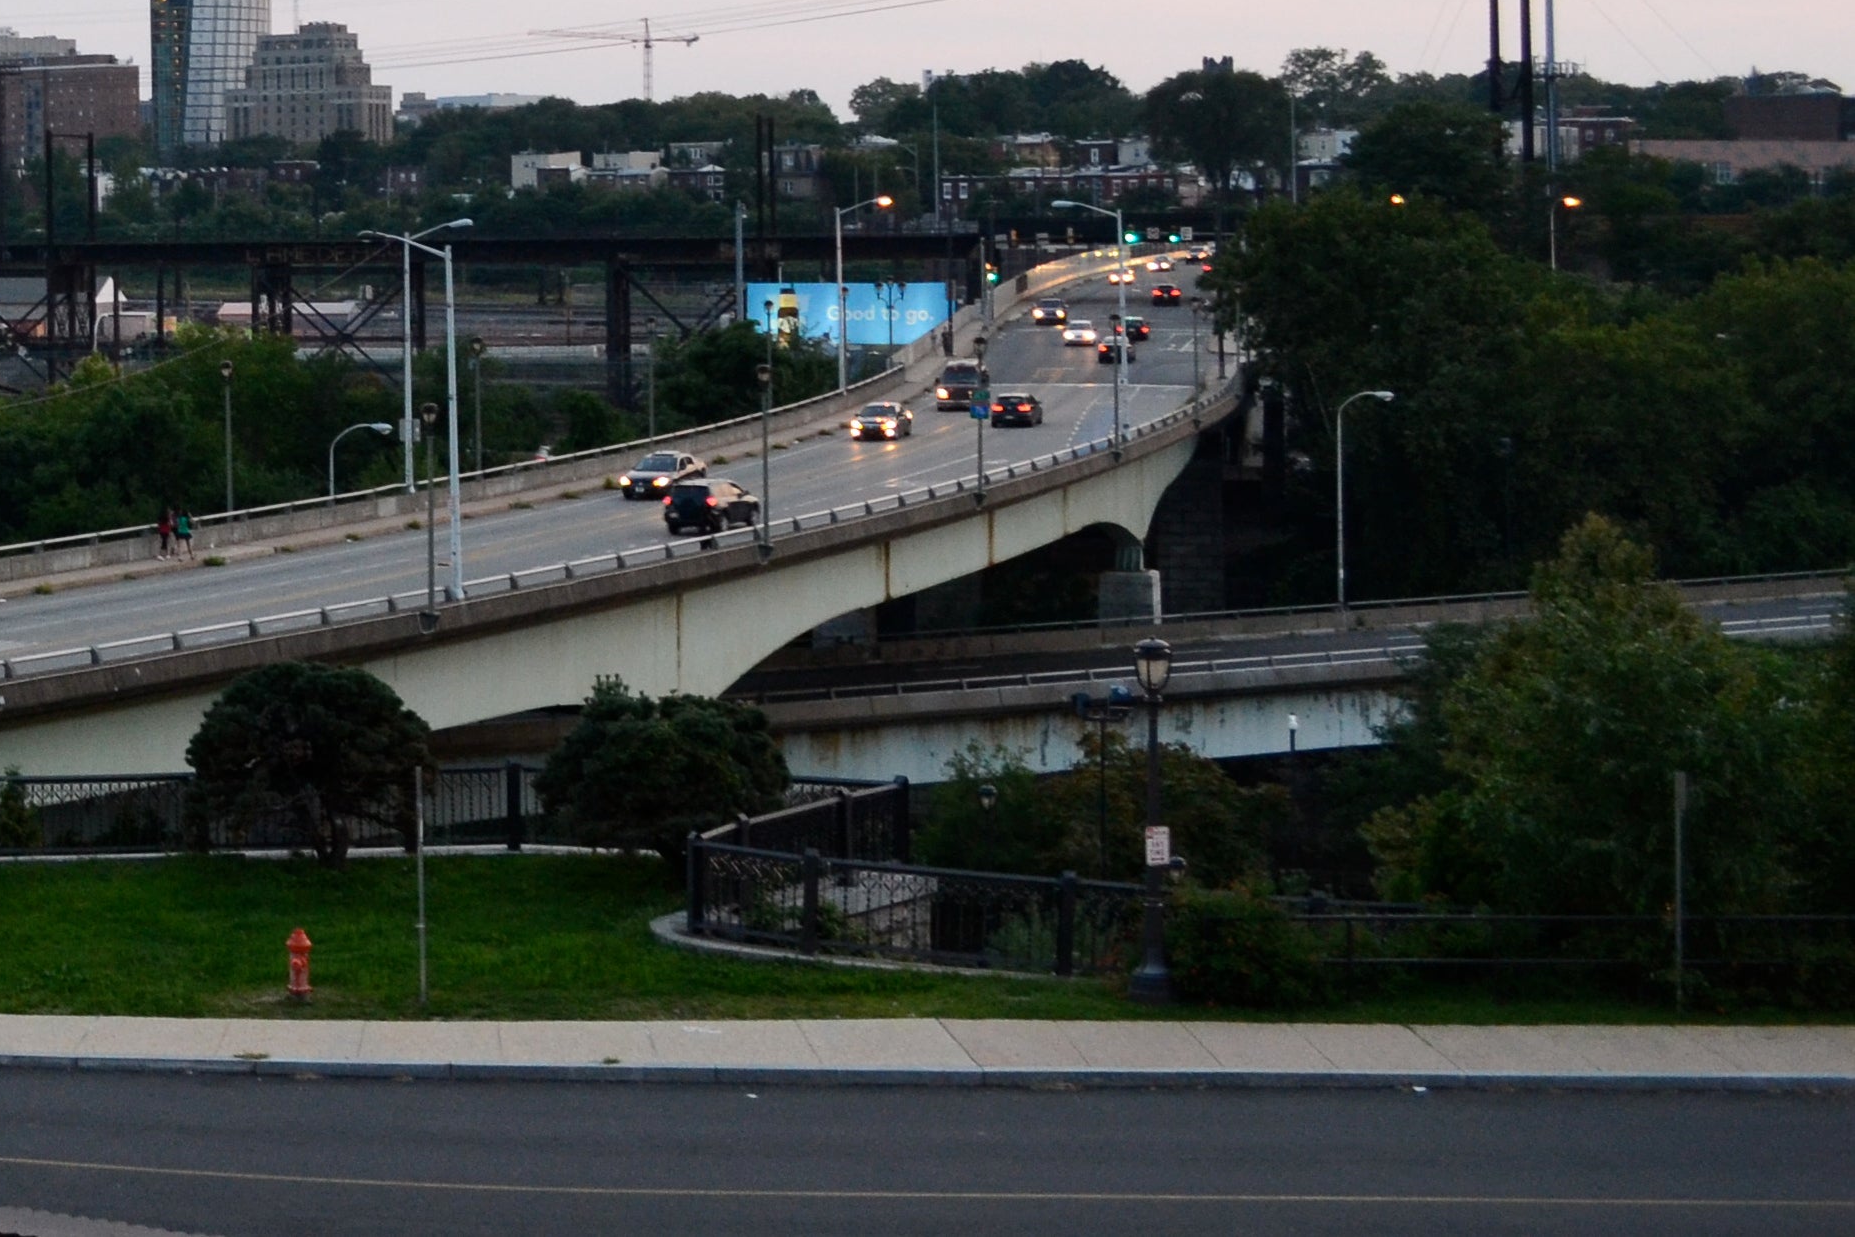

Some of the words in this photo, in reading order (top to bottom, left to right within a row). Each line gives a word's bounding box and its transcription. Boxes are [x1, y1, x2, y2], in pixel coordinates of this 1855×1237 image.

[827, 305, 875, 321] Good
[881, 306, 900, 321] to
[906, 310, 934, 325] go.
